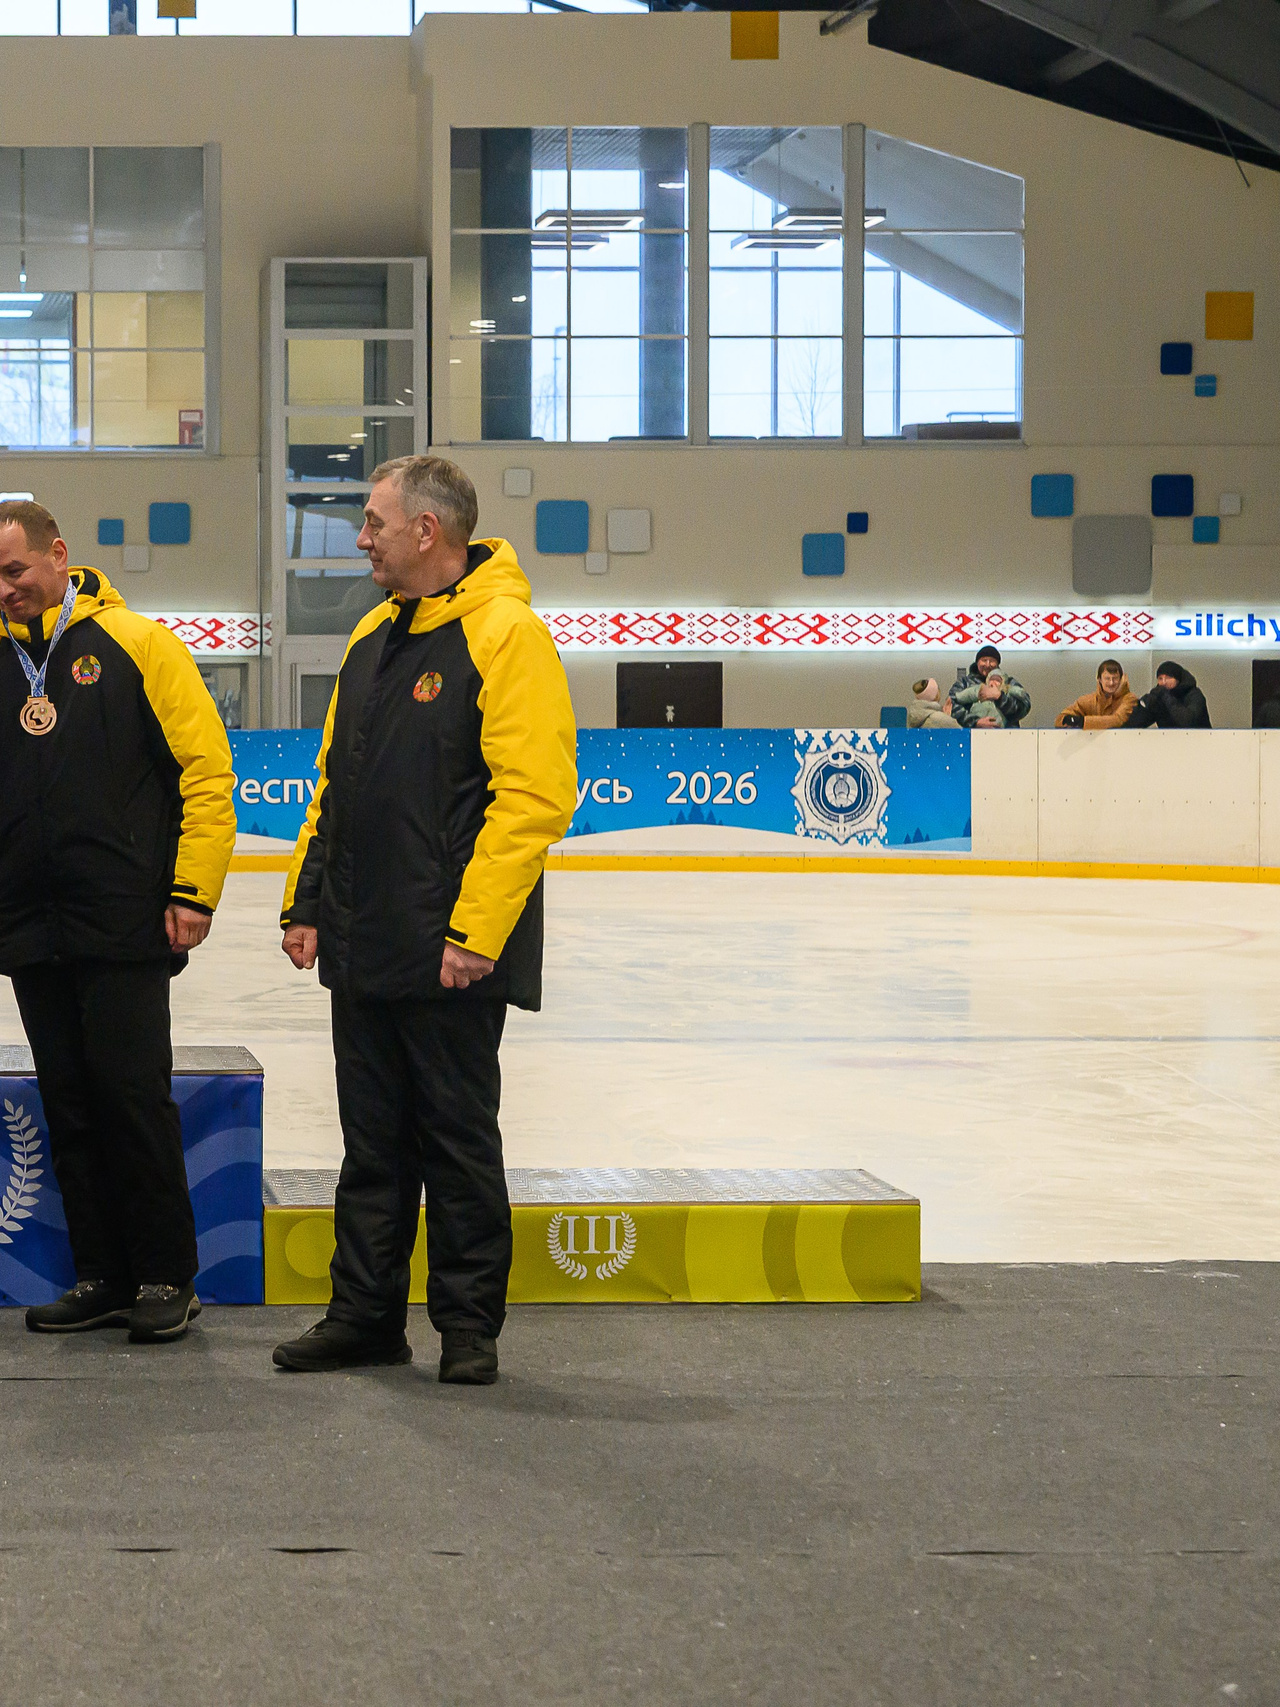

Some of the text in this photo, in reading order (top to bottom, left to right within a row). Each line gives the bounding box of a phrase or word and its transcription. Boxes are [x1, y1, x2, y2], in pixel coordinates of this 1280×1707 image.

[232, 770, 315, 804] есп
[575, 777, 634, 812] усь
[665, 770, 759, 805] 2026
[562, 1215, 623, 1254] III
